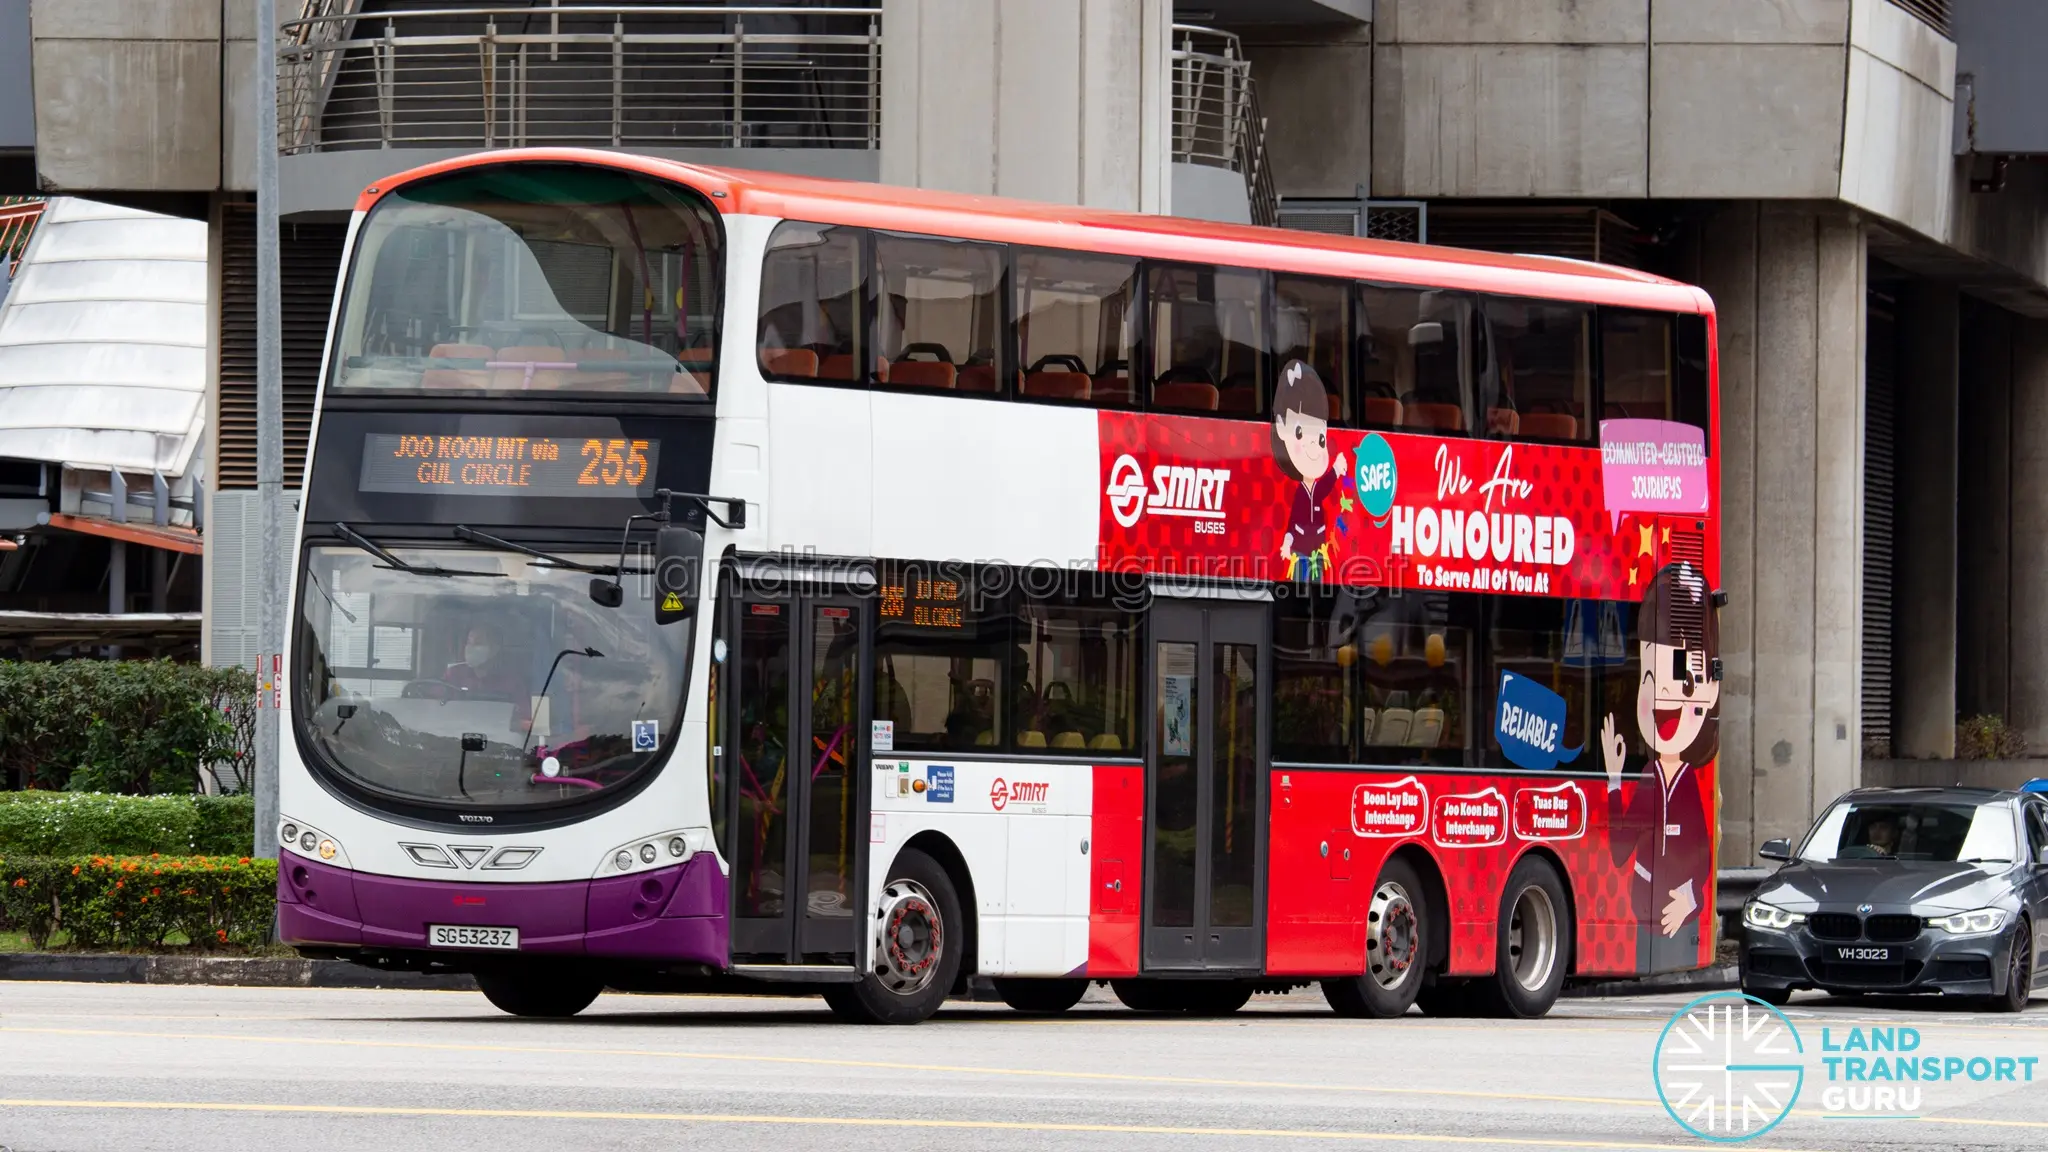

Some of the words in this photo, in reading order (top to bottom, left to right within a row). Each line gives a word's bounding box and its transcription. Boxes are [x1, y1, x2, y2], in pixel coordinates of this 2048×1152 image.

[394, 436, 434, 458] JOO
[438, 437, 493, 459] KOON
[496, 437, 529, 460] INT
[532, 438, 559, 461] via
[1602, 441, 1705, 466] COMMUTER-CENTRIC
[577, 440, 649, 486] 255
[417, 463, 454, 484] GUL
[461, 464, 532, 486] CIRCLE
[1360, 462, 1392, 493] SAFE
[1434, 443, 1473, 502] We
[1478, 444, 1534, 513] Are
[1147, 465, 1231, 511] SMRT
[1631, 475, 1682, 500] JOURNEYS
[1194, 520, 1226, 535] BUSES
[1391, 505, 1575, 567] HONOURED
[1417, 564, 1432, 587] To
[1434, 565, 1470, 589] Serve
[1472, 567, 1490, 590] All
[1491, 568, 1508, 592] Of
[1508, 570, 1533, 593] You
[1534, 571, 1549, 594] At
[1501, 701, 1558, 753] RELIABLE
[1010, 781, 1050, 802] SMRT
[1363, 790, 1386, 806] Boon
[1386, 791, 1402, 810] Lay
[1403, 792, 1418, 807] Bus
[1444, 801, 1459, 817] Joo
[1460, 801, 1482, 817] Koon
[1483, 802, 1498, 818] Bus
[1533, 795, 1552, 811] Tuas
[1553, 796, 1568, 811] Bus
[458, 814, 494, 823] VOLVO
[1365, 810, 1415, 831] Interchange
[1532, 813, 1568, 830] Terminal
[1446, 820, 1495, 840] Interchange
[436, 927, 512, 946] SG5323Z
[1838, 947, 1889, 961] VH3023
